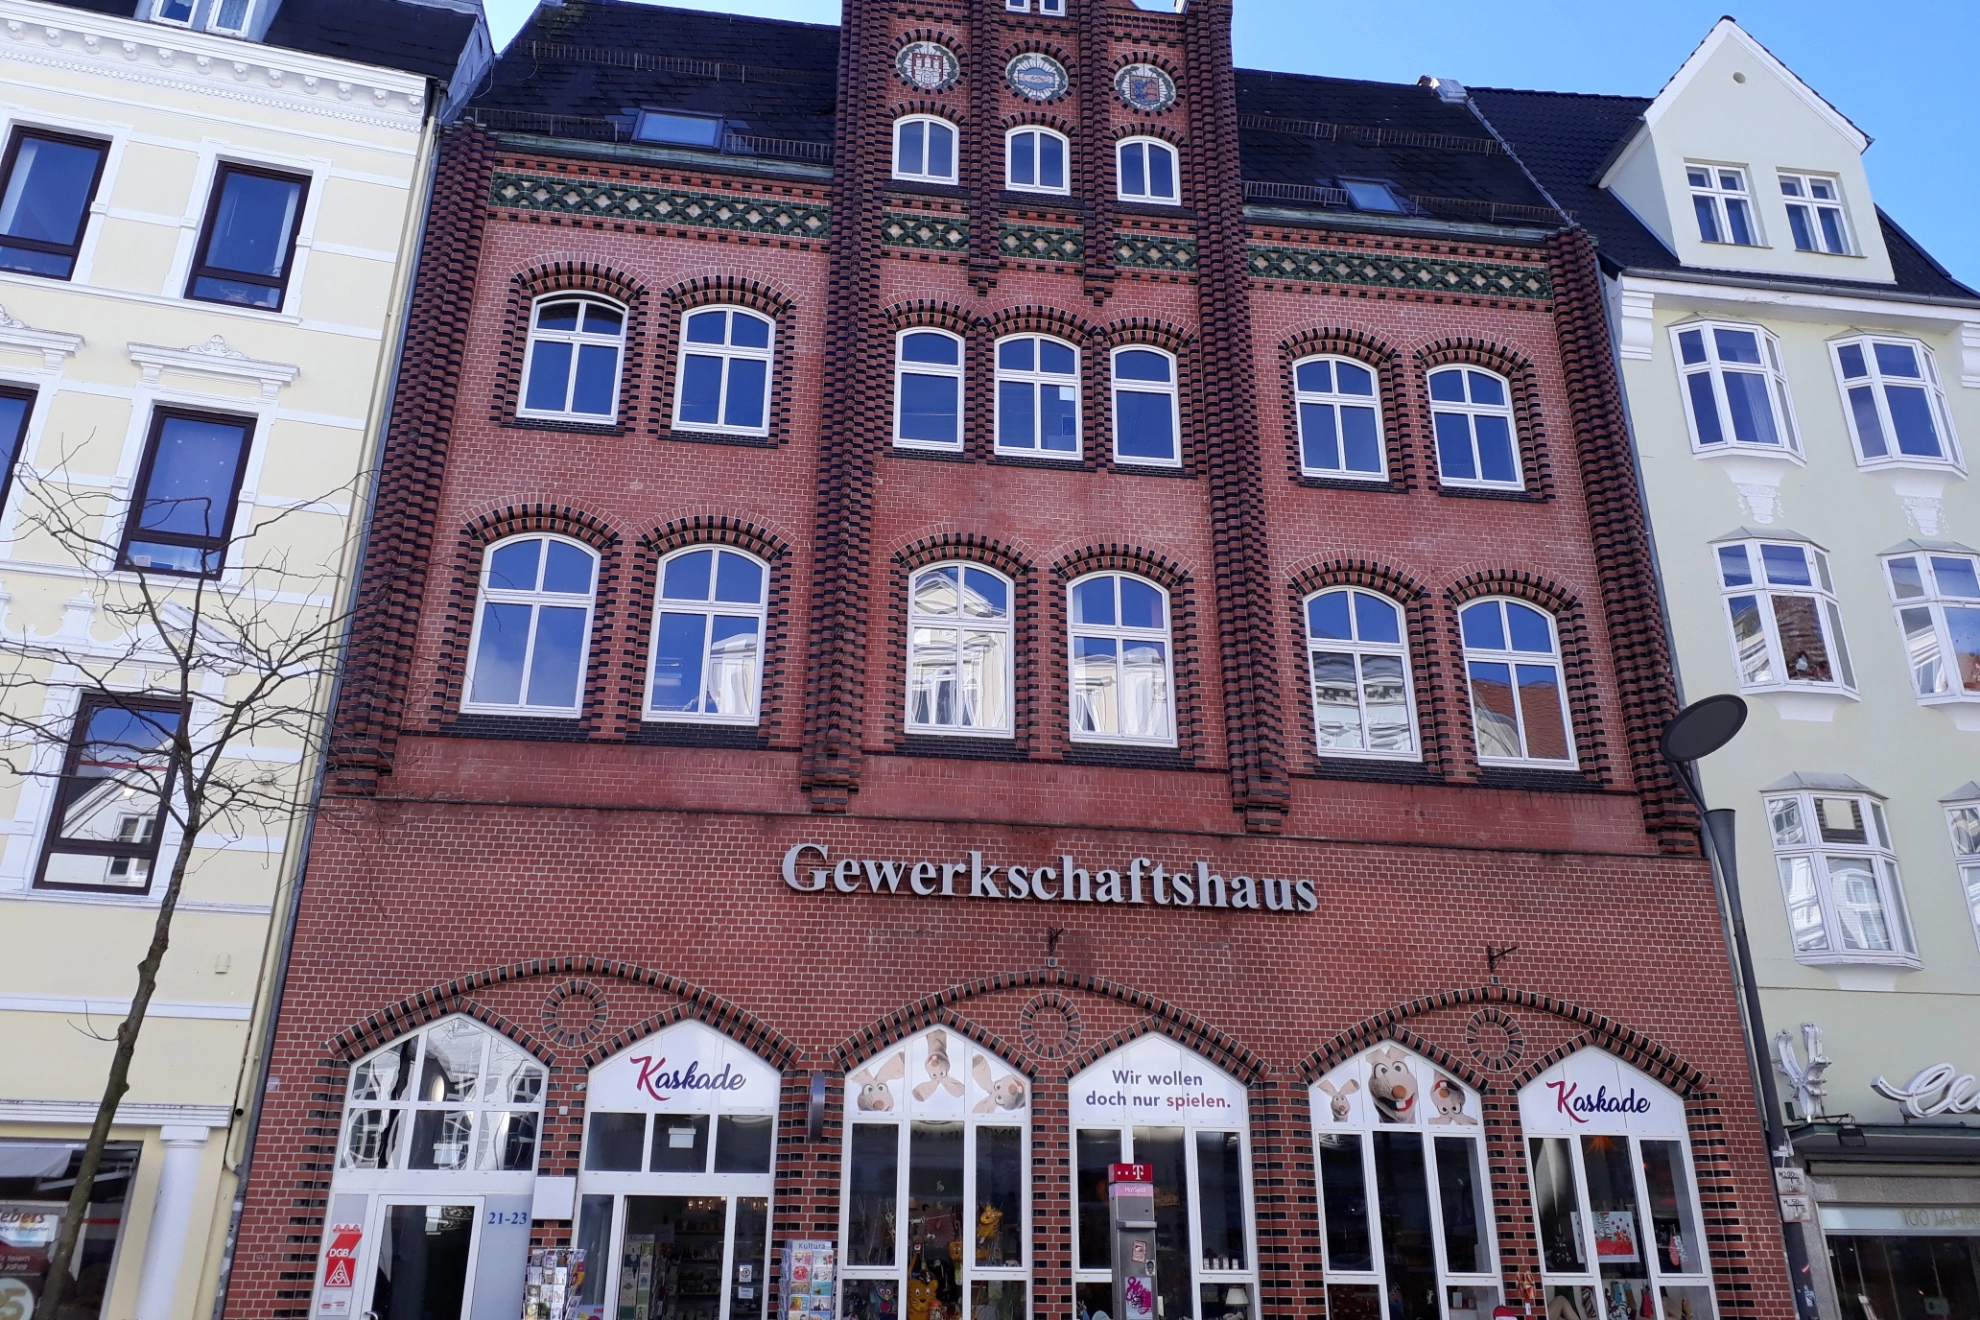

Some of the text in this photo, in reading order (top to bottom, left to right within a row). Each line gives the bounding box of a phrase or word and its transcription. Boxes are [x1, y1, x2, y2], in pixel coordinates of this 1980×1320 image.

[782, 842, 1319, 912] Gewerkschaftshaus
[630, 1055, 747, 1102] Kaskade
[1112, 1069, 1203, 1086] Wir wollen
[1085, 1090, 1231, 1111] doch nur spielen.
[1546, 1080, 1651, 1124] Kaskade
[1124, 1185, 1147, 1194] HotSpot
[487, 1211, 528, 1225] 21-23
[329, 1248, 350, 1258] DGB
[798, 1241, 826, 1250] Kultura
